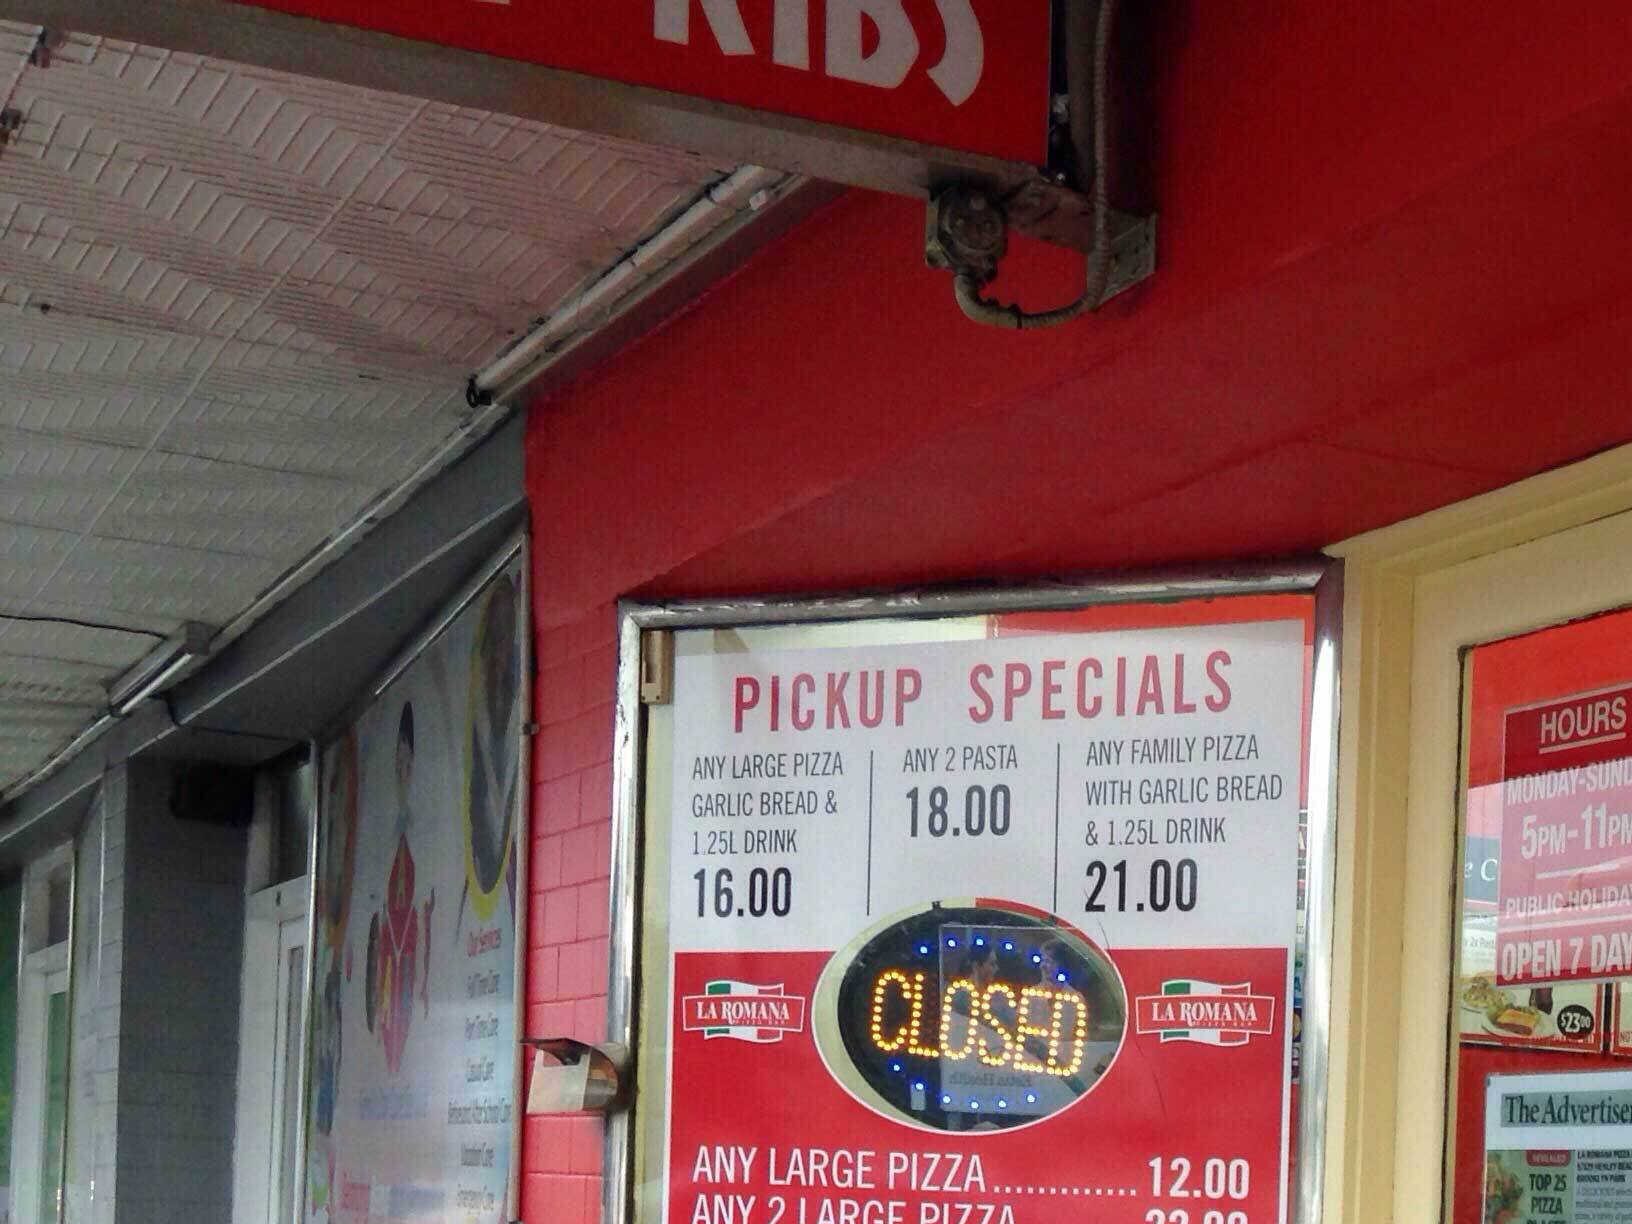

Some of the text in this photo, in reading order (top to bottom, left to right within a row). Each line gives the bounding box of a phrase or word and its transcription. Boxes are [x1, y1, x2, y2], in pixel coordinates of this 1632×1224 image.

[734, 650, 1231, 733] PICKUP SPECIALS
[1541, 697, 1626, 743] HOURS
[692, 751, 843, 779] ANY LARGE PIZZA
[903, 745, 1018, 773] ANY 2 PASTA
[1086, 735, 1259, 766] ANY FAMILY PIZZA
[692, 790, 838, 818] GARLIC BREAD &
[1085, 774, 1282, 806] WITH GARLIC BREAD
[904, 784, 1011, 837] 18.00
[692, 829, 797, 855] 1.25L DRINK
[1085, 817, 1226, 847] & 1.25L DRINK
[693, 867, 791, 917] 16.00
[1084, 858, 1197, 913] 21.00
[1506, 892, 1563, 918] PUBLIC
[1502, 939, 1561, 980] OPEN
[1569, 937, 1584, 974] 7
[696, 1001, 789, 1024] LA ROMANA
[872, 971, 1086, 1077] CLOSED
[1152, 1002, 1257, 1026] LA ROMANA
[1505, 1096, 1540, 1124] The
[692, 1145, 1251, 1199] ANY LARGE PIZZA 12.00
[1529, 1173, 1567, 1192] TOP 25
[1531, 1196, 1563, 1214] PIZZA
